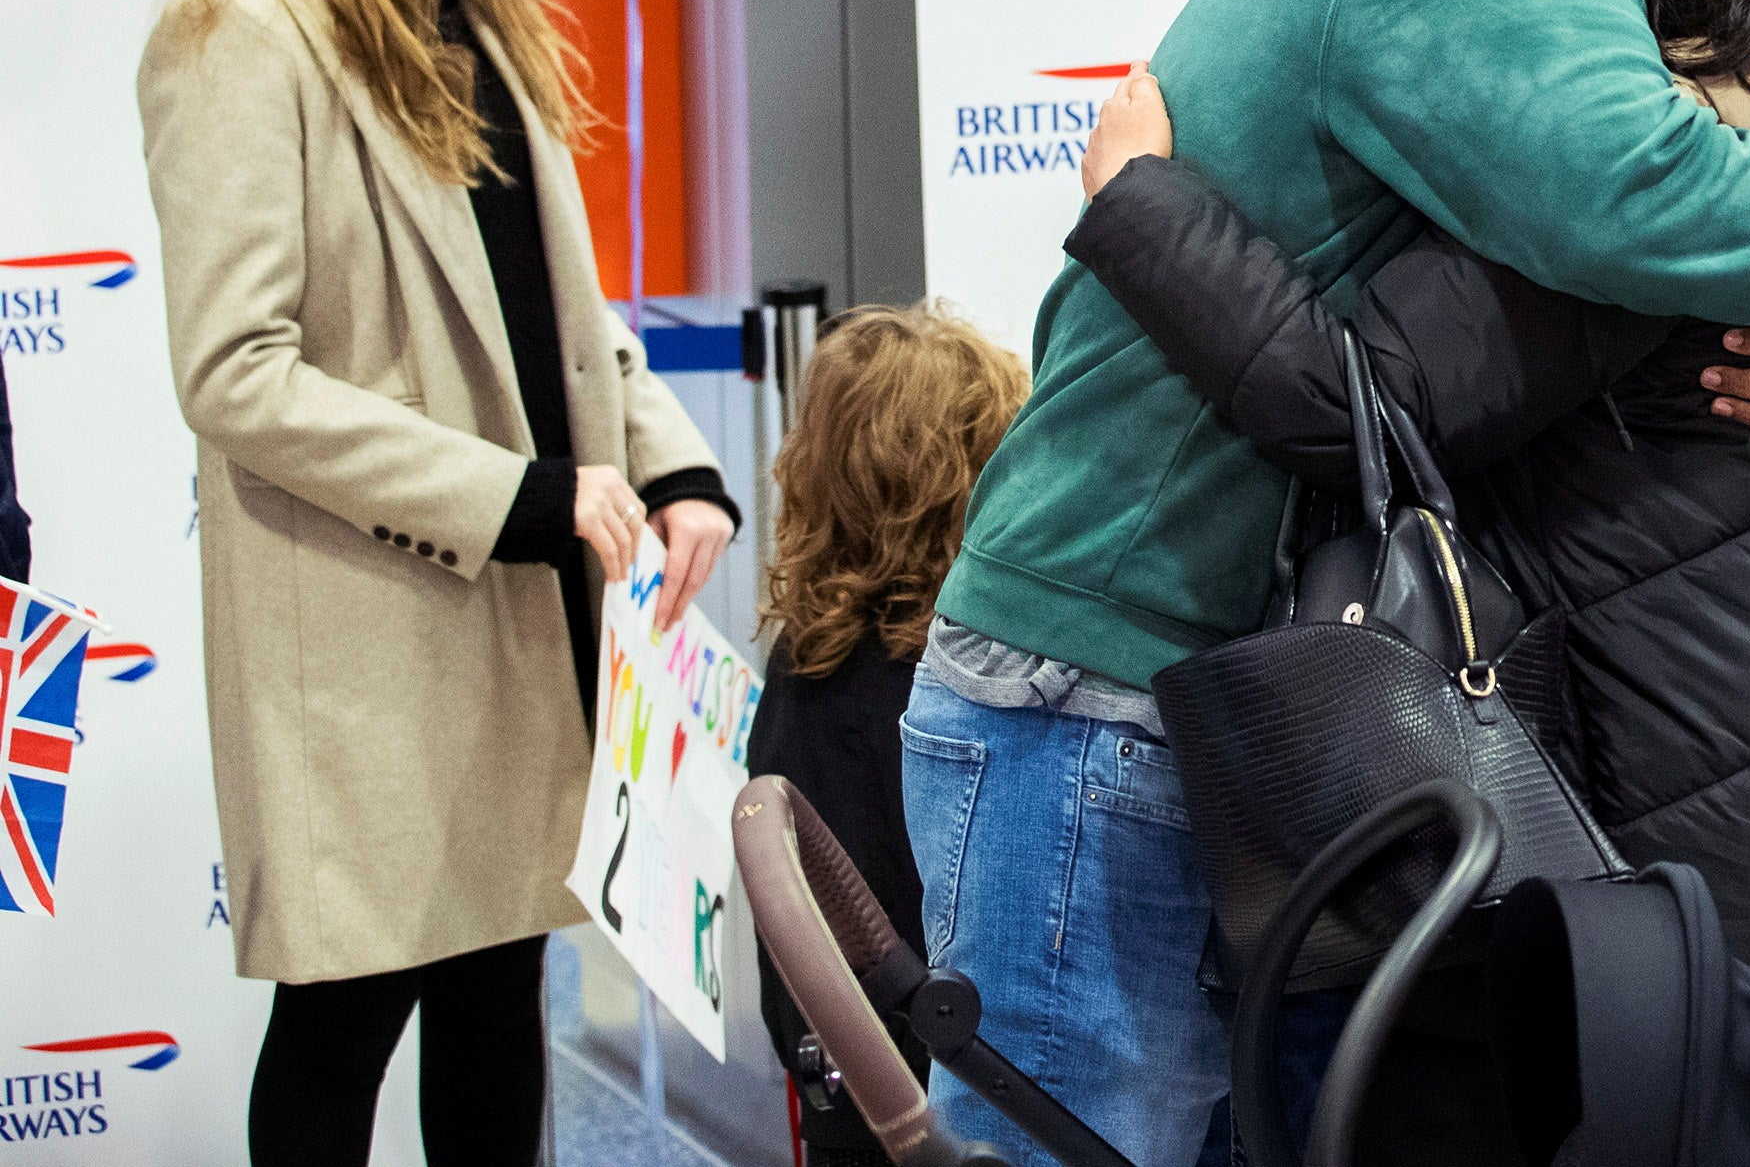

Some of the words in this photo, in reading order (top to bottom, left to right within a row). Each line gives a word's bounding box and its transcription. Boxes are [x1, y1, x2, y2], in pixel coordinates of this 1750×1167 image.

[605, 625, 653, 783] YOU
[667, 620, 764, 767] MISSE
[602, 781, 630, 935] 2
